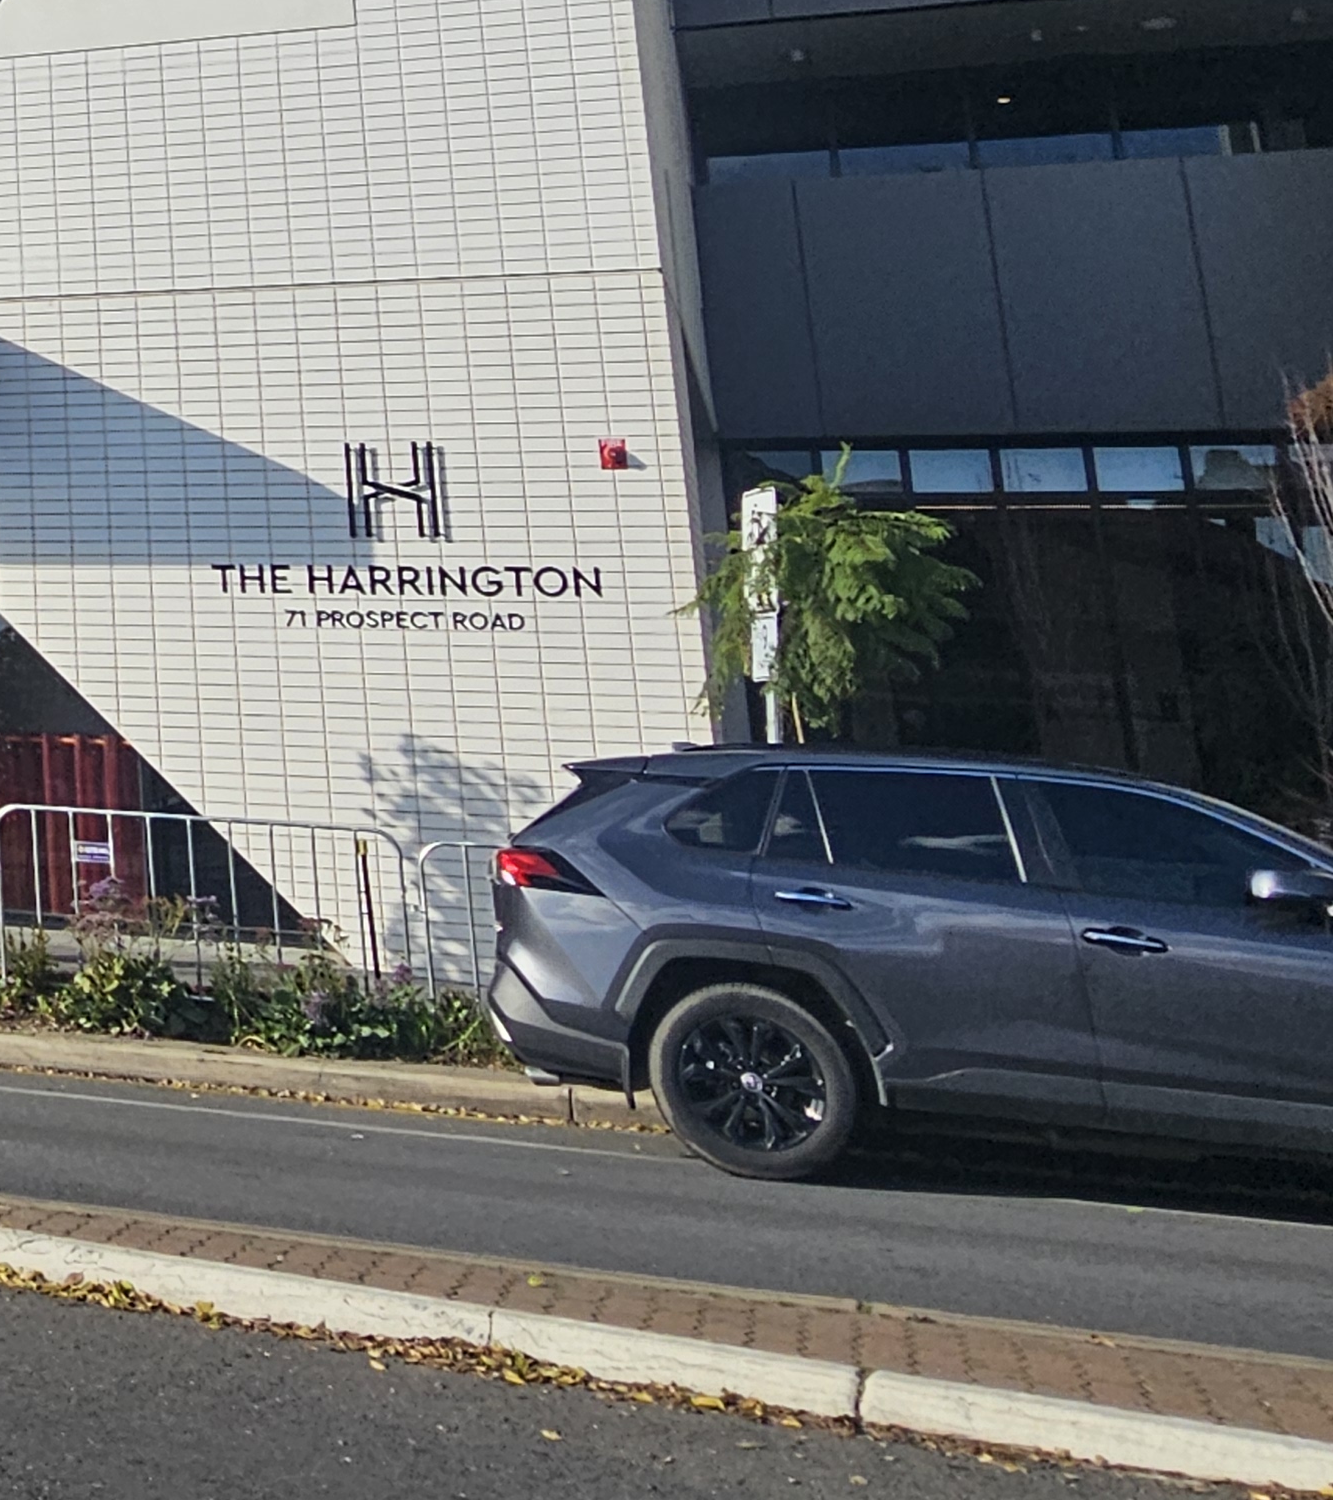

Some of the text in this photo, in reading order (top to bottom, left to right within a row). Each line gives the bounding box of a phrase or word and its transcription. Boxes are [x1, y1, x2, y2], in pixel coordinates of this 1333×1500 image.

[211, 563, 604, 598] THE HARRINGTON
[284, 609, 526, 632] 71 PROSPECT ROAD
